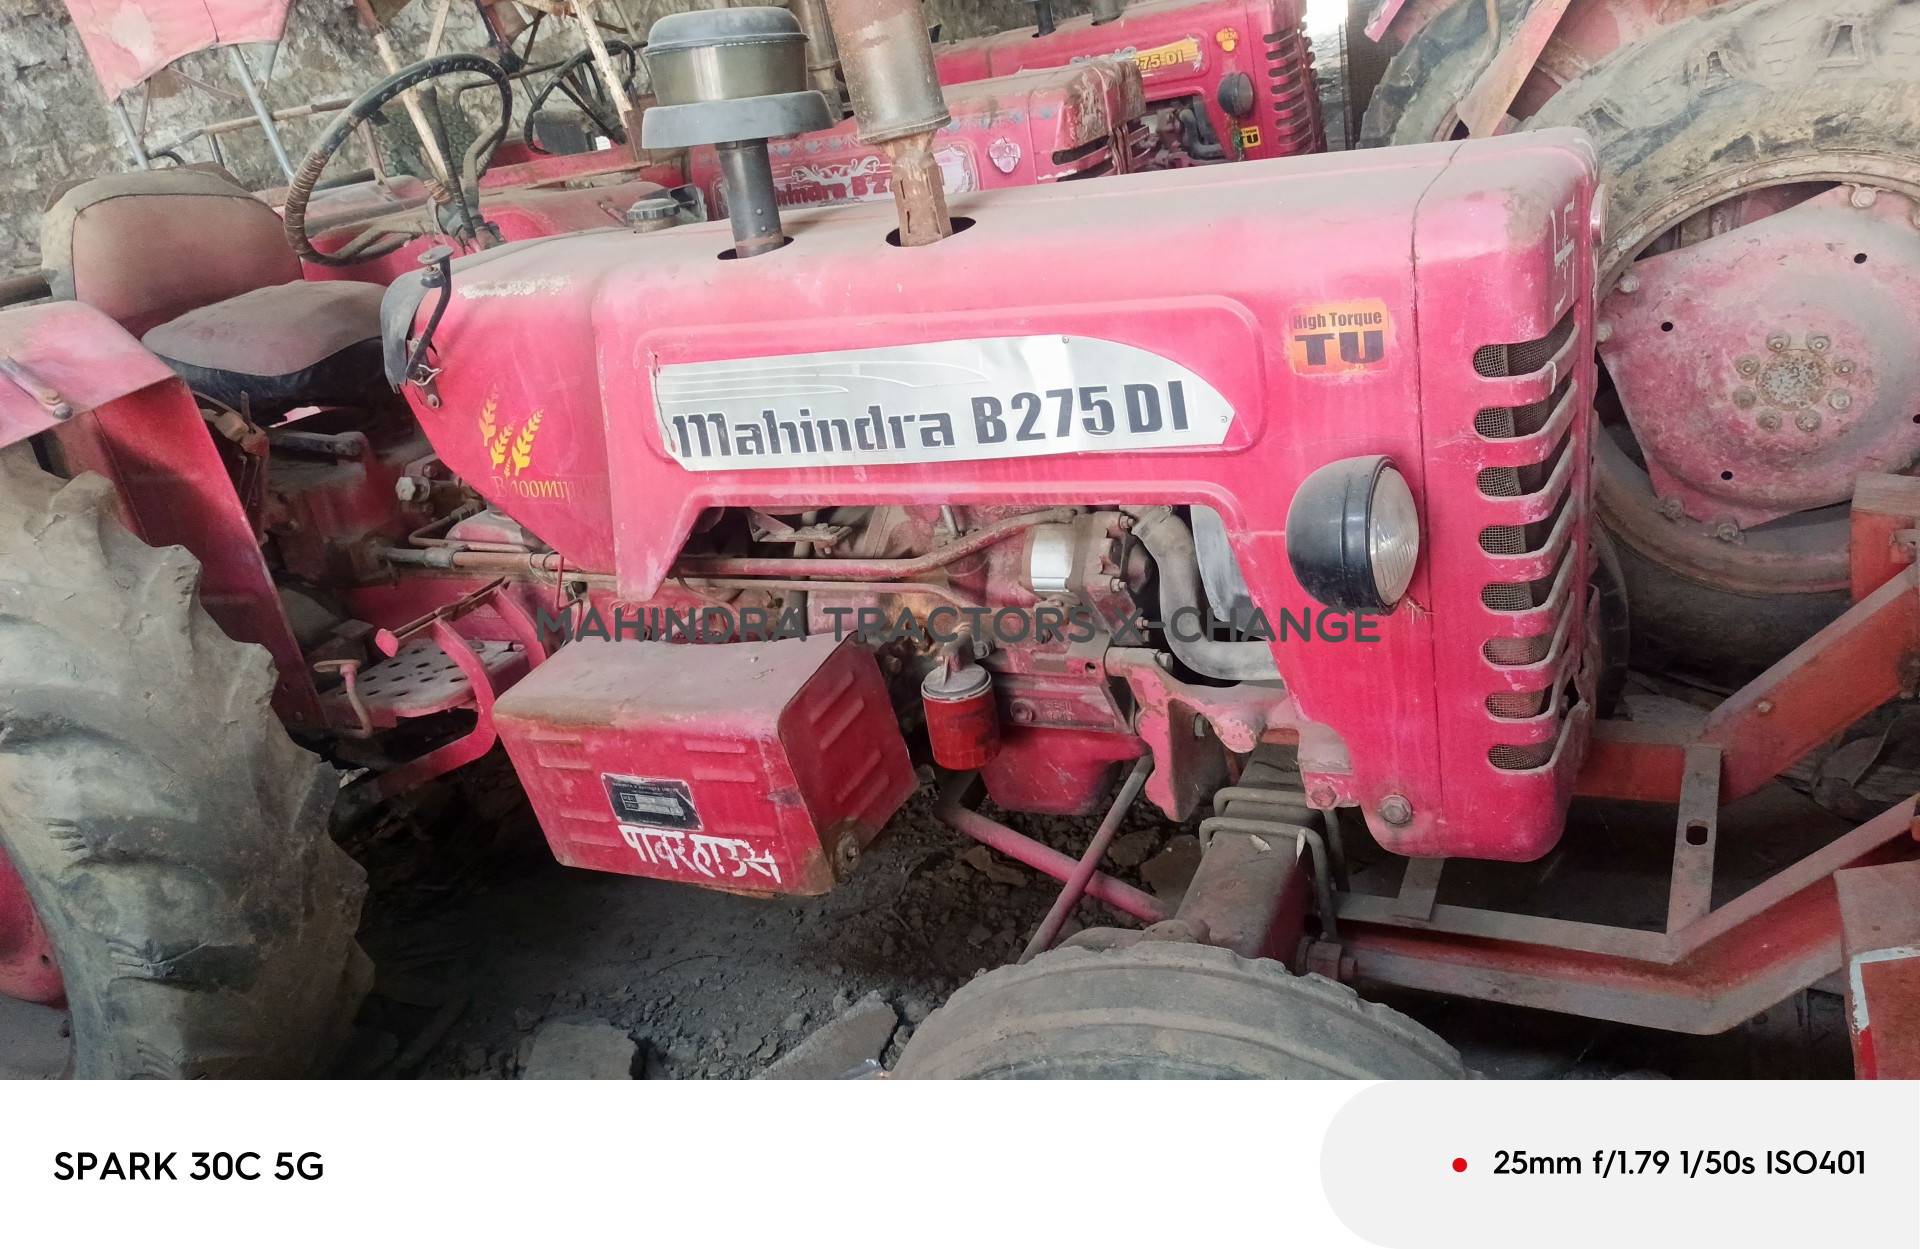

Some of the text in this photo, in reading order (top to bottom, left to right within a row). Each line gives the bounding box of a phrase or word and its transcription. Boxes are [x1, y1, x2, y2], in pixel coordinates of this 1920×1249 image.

[1165, 50, 1183, 64] DI
[1293, 311, 1383, 330] High Torque
[1294, 330, 1385, 366] TU
[672, 404, 957, 458] Mahindra
